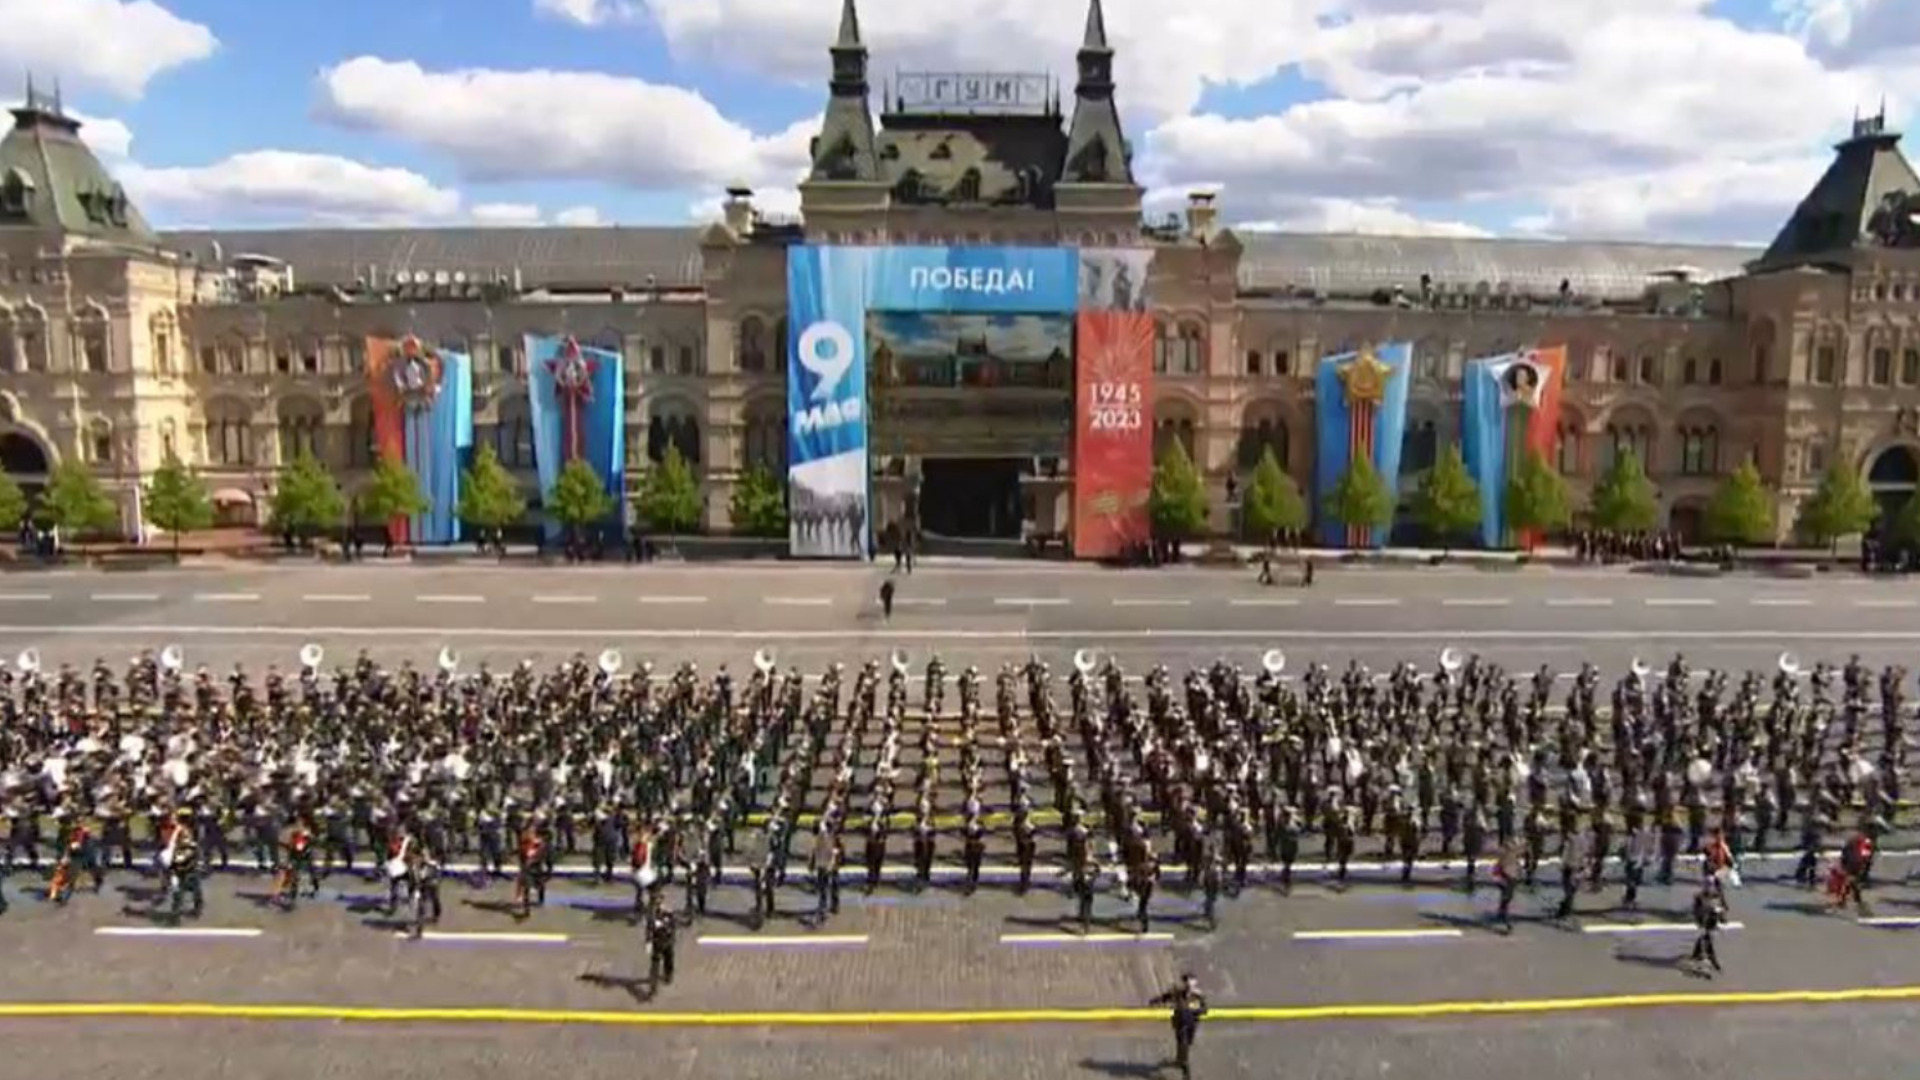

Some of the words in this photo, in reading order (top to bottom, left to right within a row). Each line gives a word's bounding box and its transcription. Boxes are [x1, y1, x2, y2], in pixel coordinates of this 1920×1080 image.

[936, 79, 1010, 100] ГУМ
[910, 266, 1035, 295] ПОБЕДА!
[799, 321, 855, 400] 9
[1091, 382, 1142, 404] 1945
[1089, 408, 1142, 430] 2023
